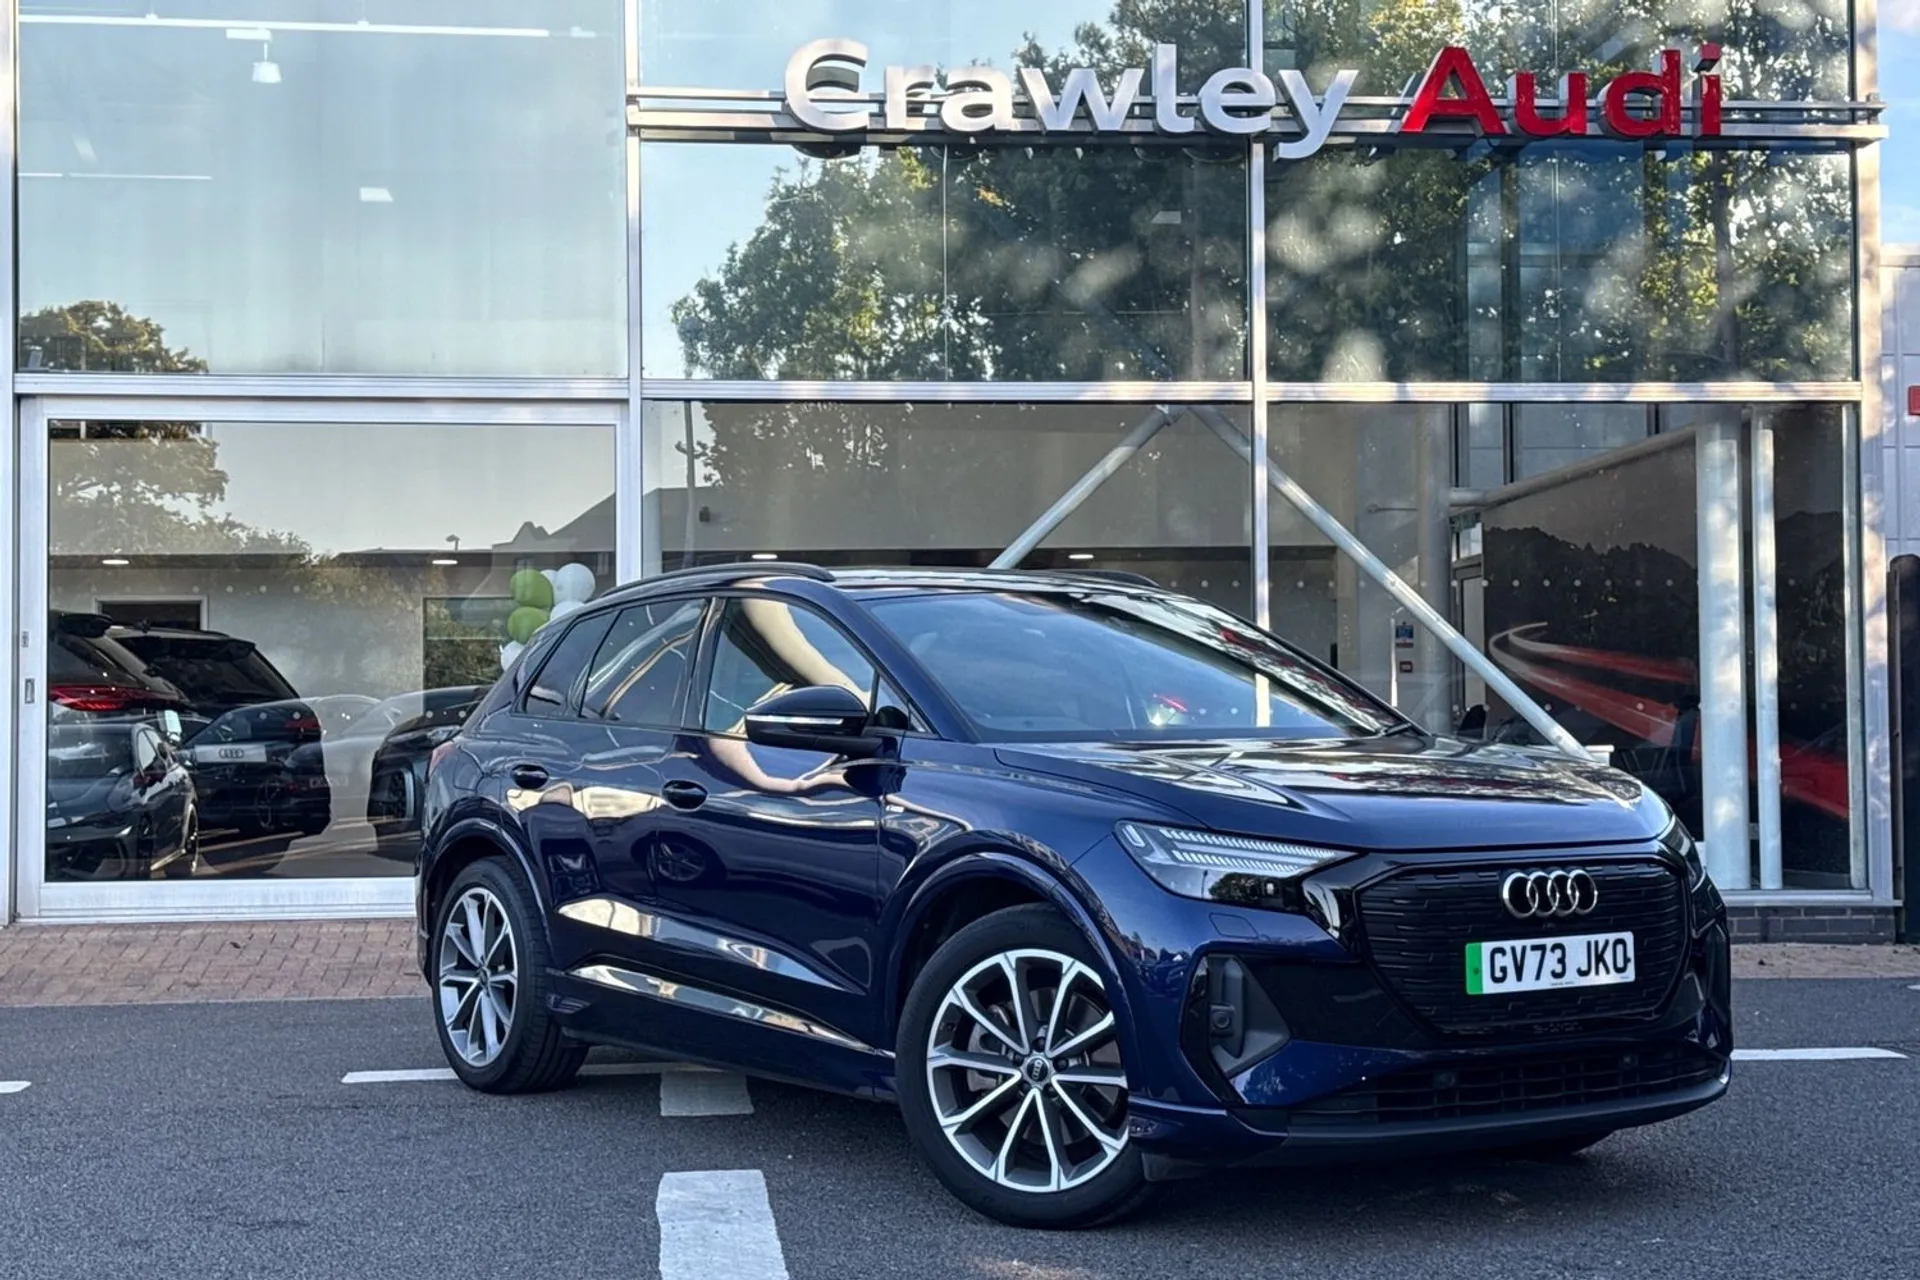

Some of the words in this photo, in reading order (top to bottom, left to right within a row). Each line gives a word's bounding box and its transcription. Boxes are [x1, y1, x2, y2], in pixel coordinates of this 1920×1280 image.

[784, 38, 1360, 161] Crawley
[1400, 43, 1723, 138] Audi
[1489, 942, 1567, 984] GV73
[1576, 937, 1629, 977] JKO
